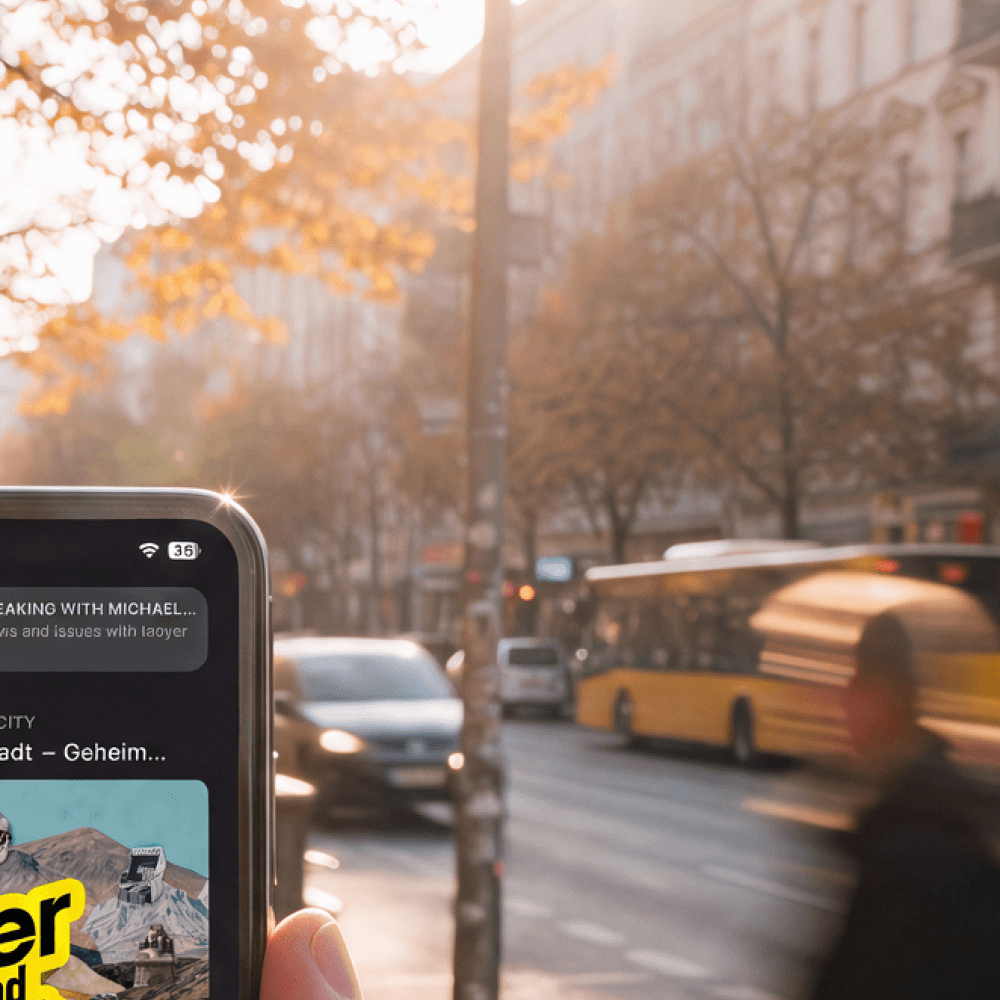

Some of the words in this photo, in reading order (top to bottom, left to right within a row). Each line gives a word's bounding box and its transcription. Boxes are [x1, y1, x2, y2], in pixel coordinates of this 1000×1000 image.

[60, 601, 104, 616] WITH
[22, 624, 49, 638] and
[53, 624, 102, 638] issues
[105, 624, 137, 638] with
